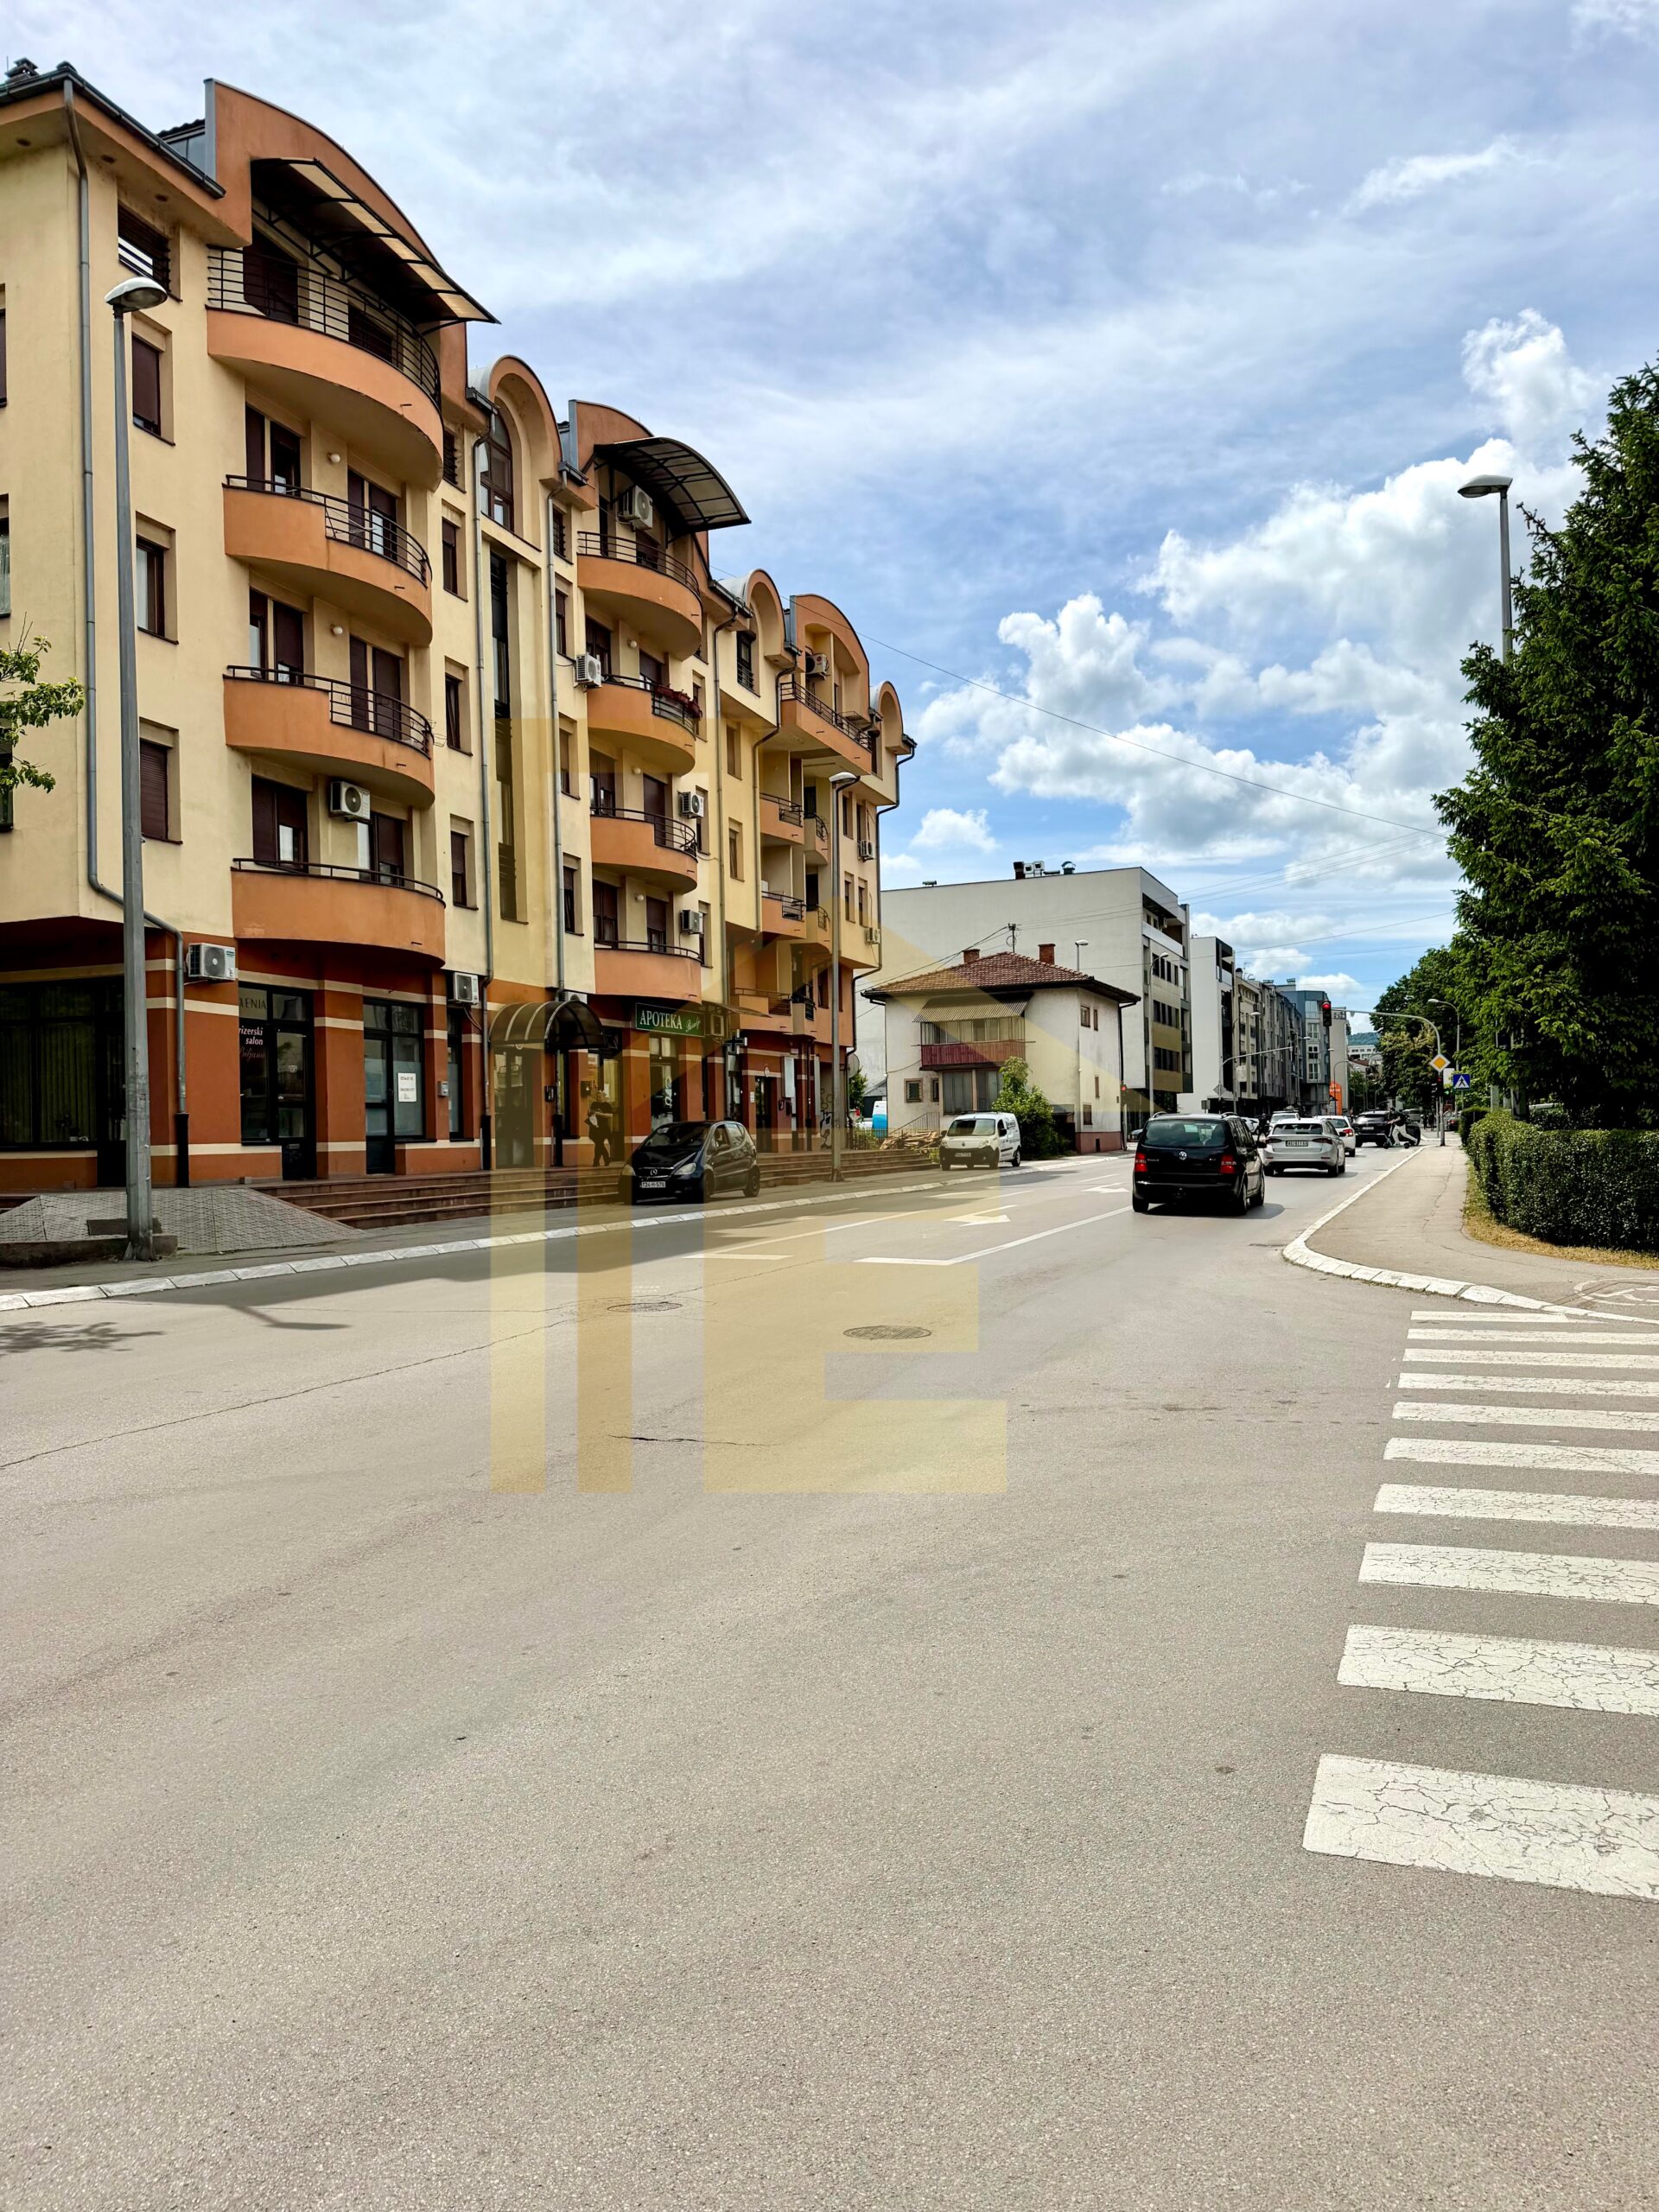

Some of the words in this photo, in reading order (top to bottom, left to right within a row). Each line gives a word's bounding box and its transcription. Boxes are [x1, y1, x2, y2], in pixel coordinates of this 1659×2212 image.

[639, 1009, 683, 1029] APOTEKA
[238, 1025, 264, 1036] rizerski
[245, 1036, 264, 1046] salon
